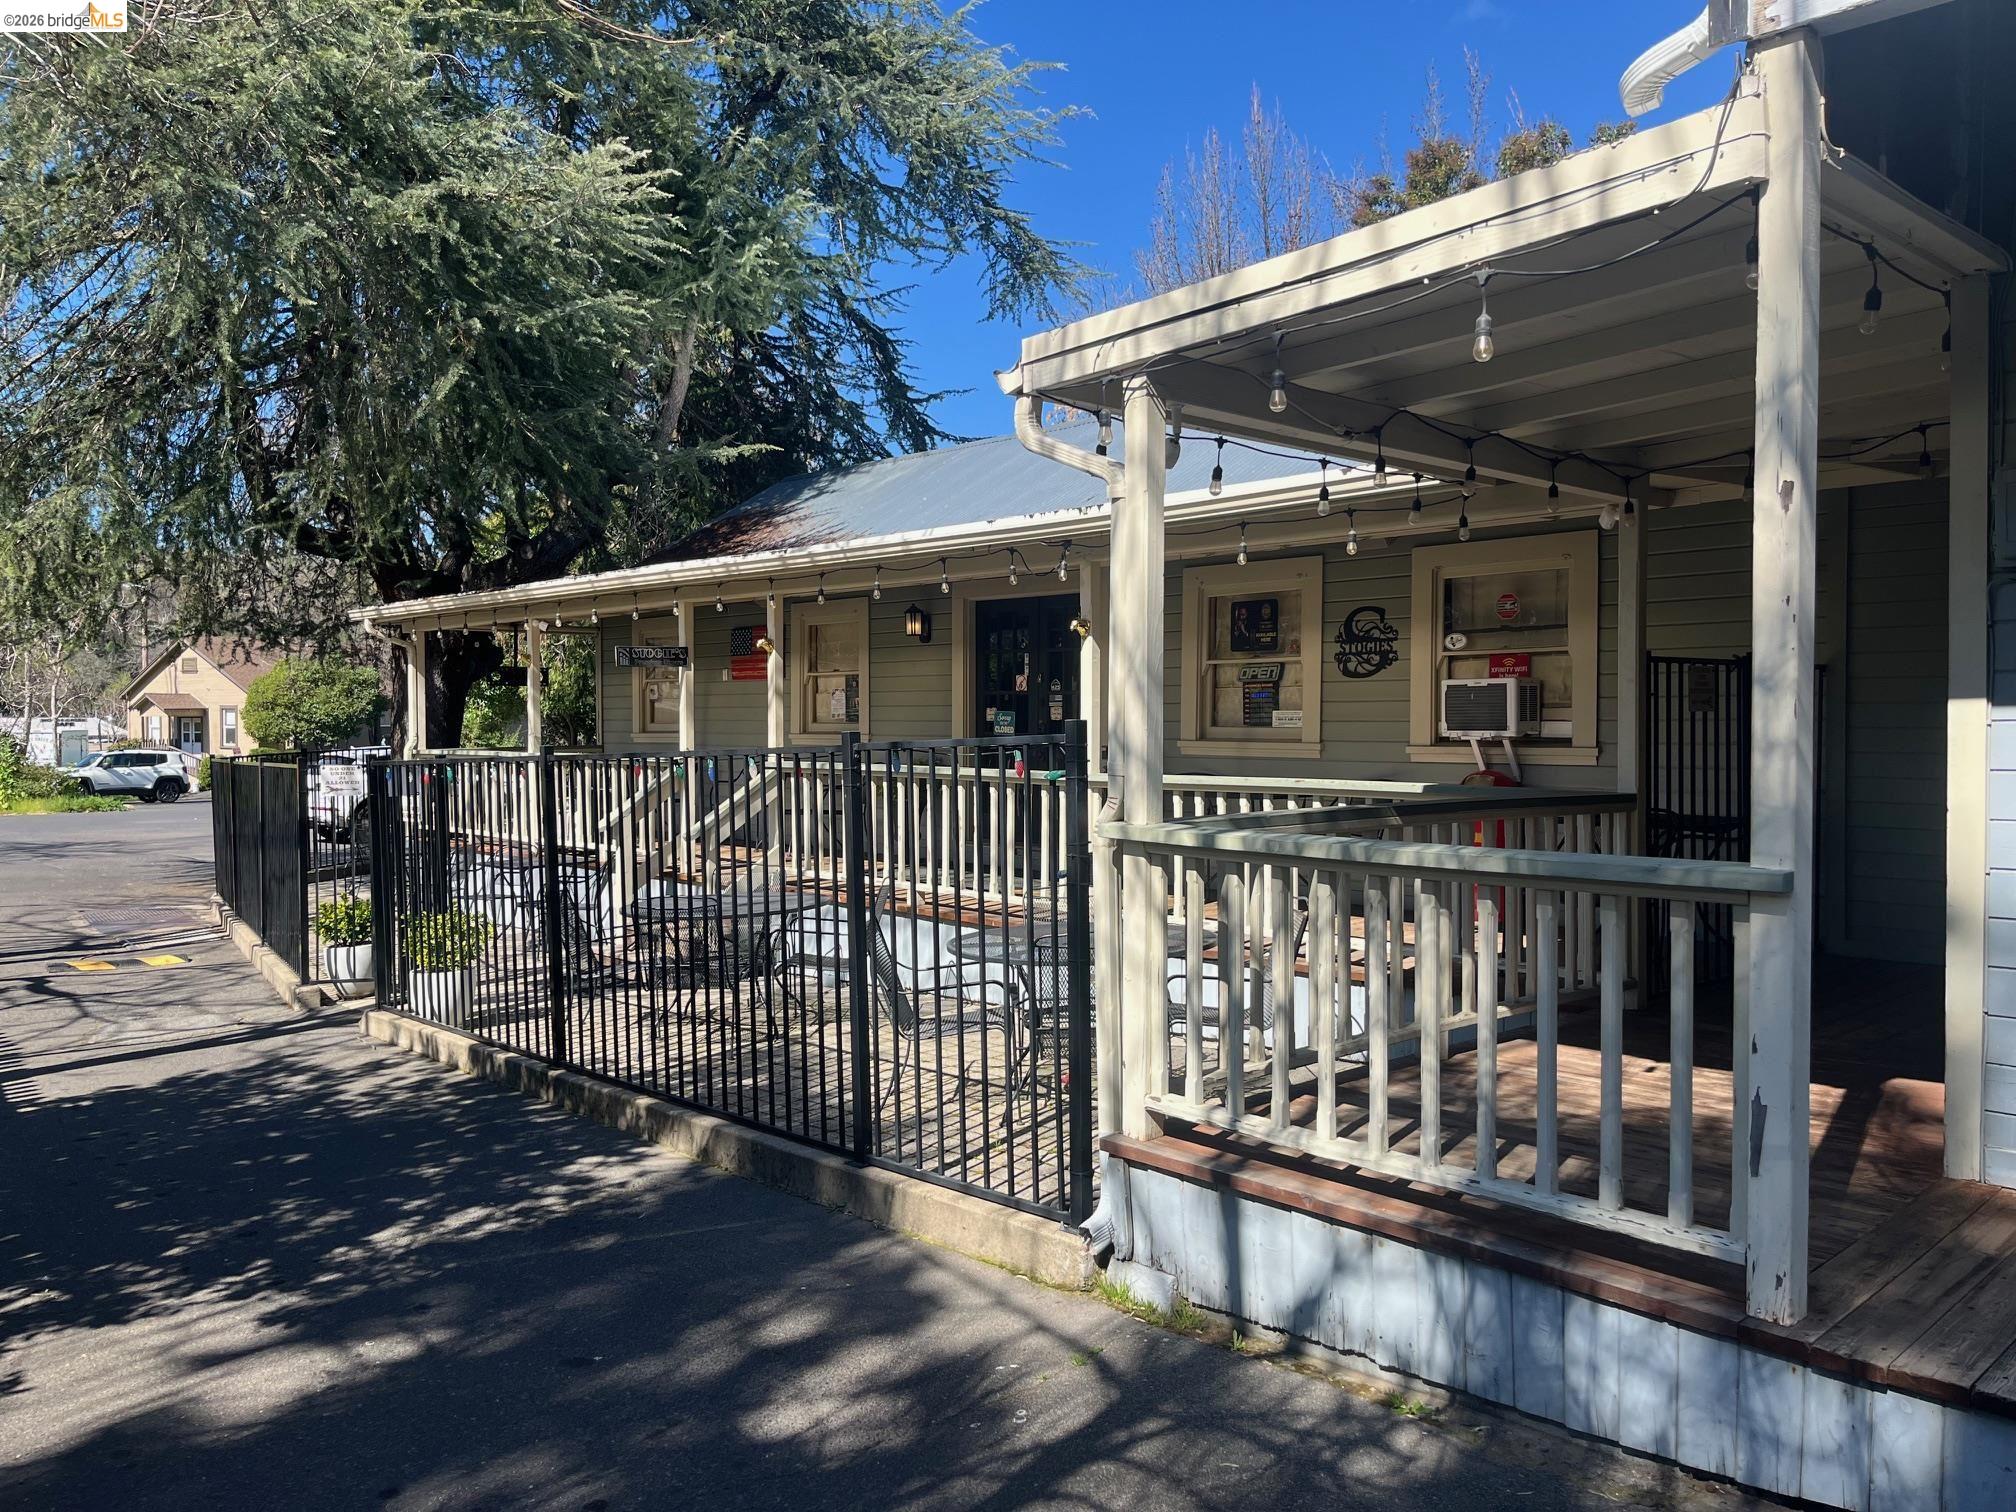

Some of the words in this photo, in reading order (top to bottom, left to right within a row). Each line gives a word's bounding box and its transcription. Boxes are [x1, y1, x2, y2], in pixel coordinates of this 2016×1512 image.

[632, 648, 687, 658] STOGIE'S
[1240, 666, 1277, 679] OPEN
[994, 725, 1015, 733] CLOSED
